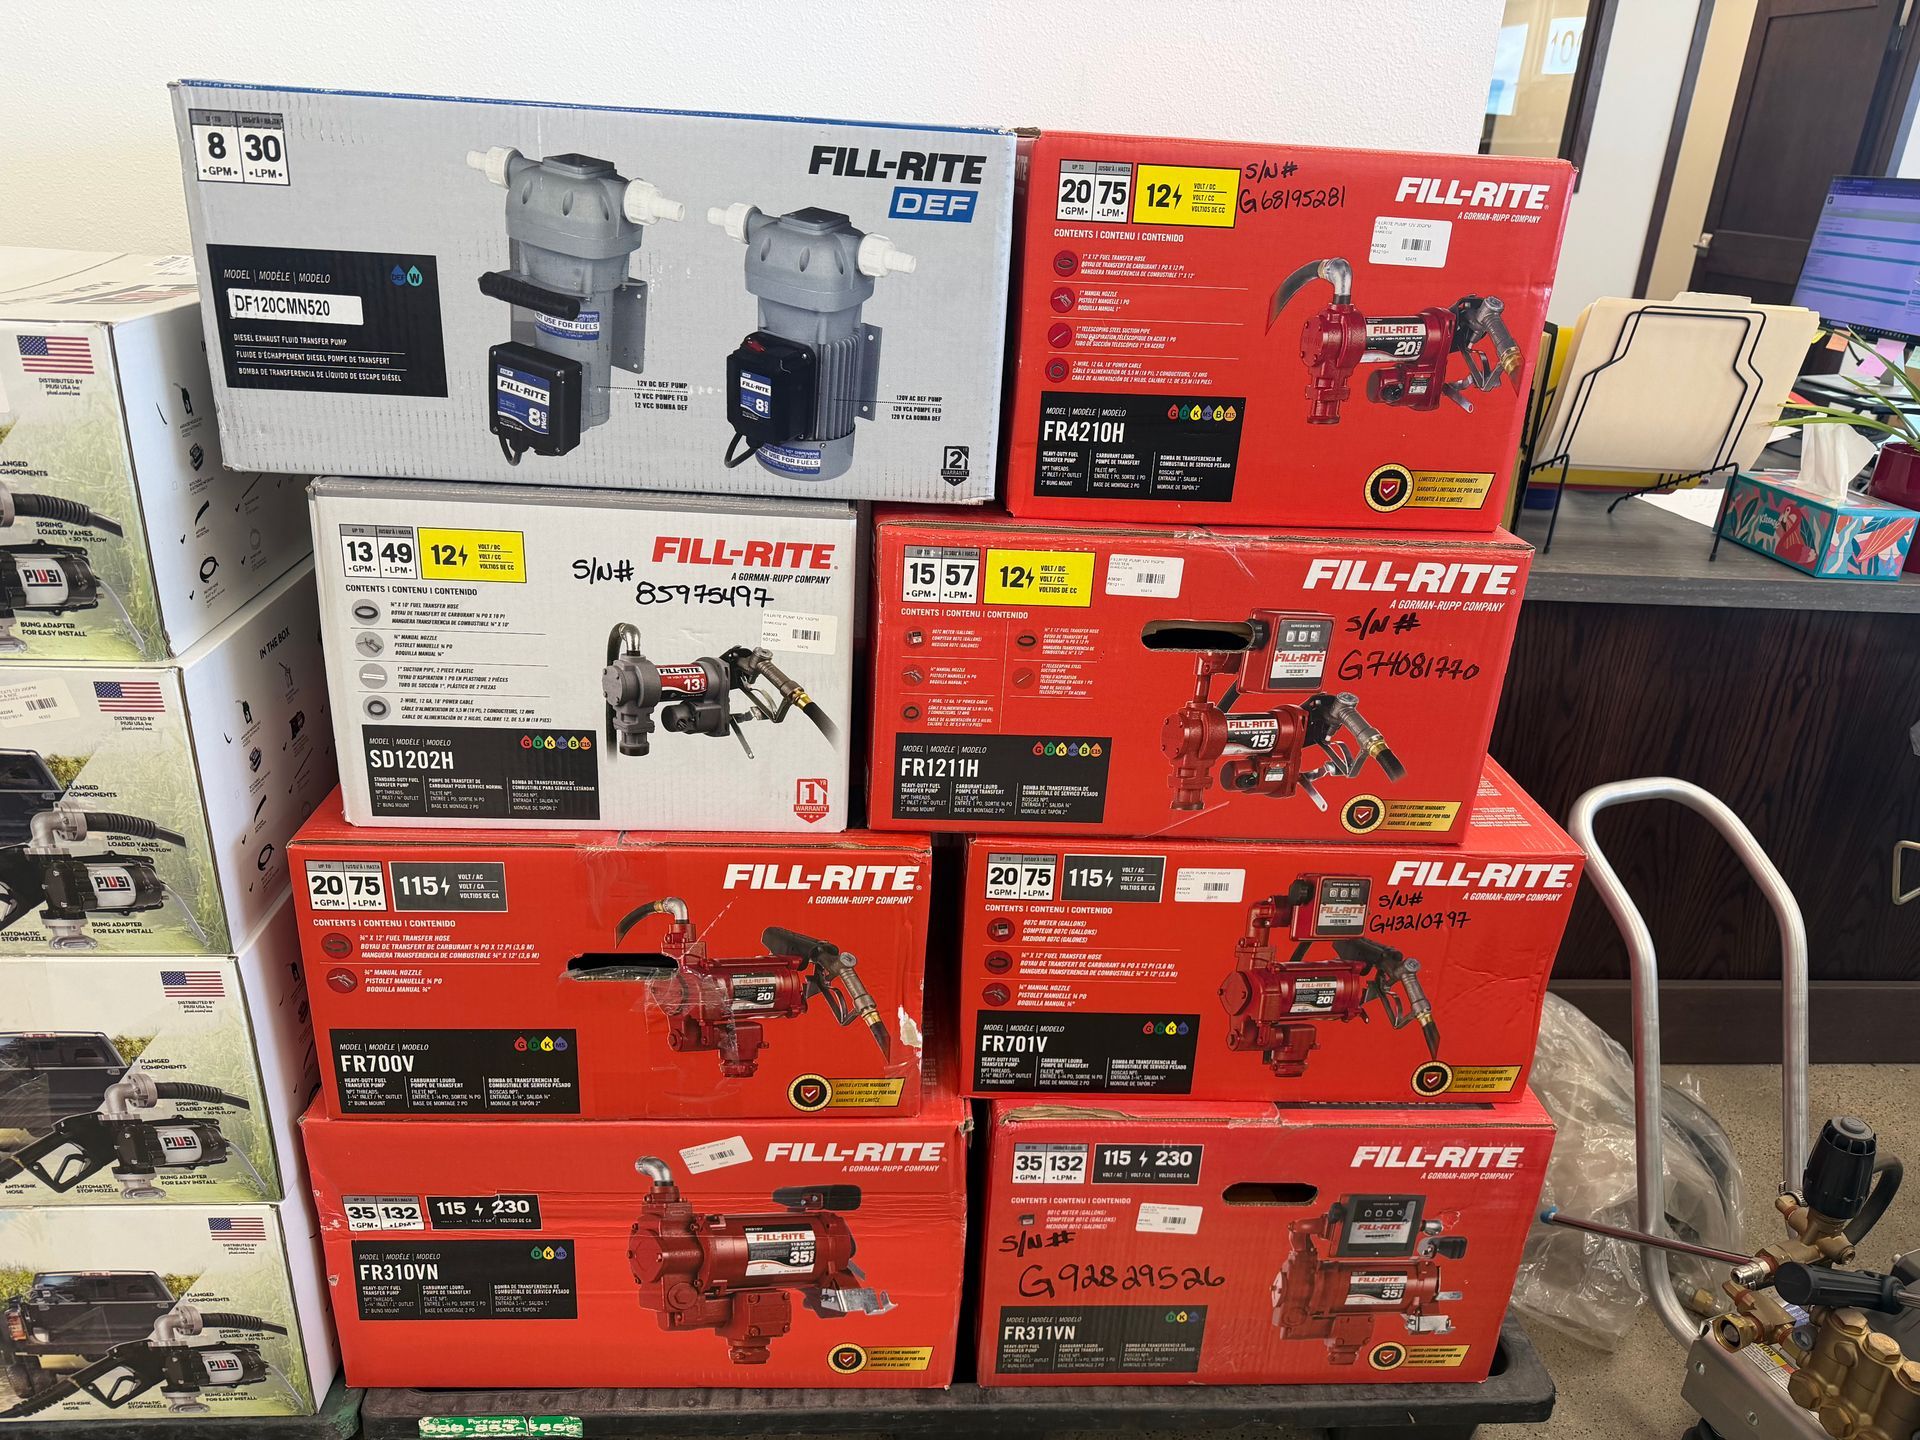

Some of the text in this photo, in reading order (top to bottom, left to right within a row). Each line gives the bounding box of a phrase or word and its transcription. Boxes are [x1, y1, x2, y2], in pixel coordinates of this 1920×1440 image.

[208, 133, 282, 162] 8 30
[208, 166, 277, 179] GPM LPM
[808, 145, 986, 184] FILL-RITE
[1061, 180, 1126, 205] 20 75
[1147, 184, 1170, 207] 12
[1240, 186, 1345, 213] G68195281
[1395, 177, 1550, 209] FILL-RITE
[896, 193, 970, 215] DEF
[1066, 207, 1120, 217] GPM LPM
[1464, 212, 1509, 222] GORMAN-RUPP
[1511, 215, 1541, 223] COMPANY
[1054, 229, 1183, 242] CONTENTS CONTENU CONTENIDO
[224, 269, 330, 284] MODEL MODÈLE MODELO
[235, 295, 330, 317] DF120CMN520
[234, 334, 347, 346] DIESEL EXHAUST FLUID TRANSFER PUMP
[1102, 409, 1126, 417] MODELO
[1044, 421, 1125, 443] FR4210H
[949, 450, 962, 468] 2
[347, 542, 412, 563] 13 49
[431, 545, 457, 565] 12
[652, 536, 835, 570] FILL-RITE
[23, 569, 62, 583] PIUSI
[739, 573, 793, 582] GORMAN-RUPP
[795, 575, 830, 584] COMPANY
[910, 563, 975, 586] 15 57
[1000, 566, 1024, 588] 12
[1303, 559, 1517, 595] FILL-RITE
[392, 586, 427, 594] CONTENU
[636, 581, 774, 608] 85975497
[901, 608, 1028, 619] CONTENTS CONTENU CONTENIDO
[1390, 601, 1505, 612] A GORMAN-RUPP COMPANY
[260, 626, 290, 660] IN THE BOX
[1275, 652, 1325, 662] FILL-RITE
[660, 666, 702, 675] FILL-RITE
[903, 745, 923, 753] MODEL
[930, 745, 955, 753] MODÈLE
[370, 750, 454, 770] SD1202H
[901, 758, 979, 777] FR1211H
[96, 876, 129, 888] PIUSI
[723, 864, 920, 890] FILL-RITE
[990, 867, 1051, 886] 20 75
[1070, 869, 1103, 888] 115
[1387, 861, 1574, 889] FILL-RITE
[311, 876, 380, 895] 20 75
[400, 877, 437, 895] 115
[816, 896, 874, 904] GORMAN-RUPP
[876, 896, 913, 904] COMPANY
[1471, 893, 1524, 901] GORMAN-RUPP
[1526, 893, 1562, 901] COMPANY
[313, 919, 356, 927] CONTENTS
[409, 920, 456, 928] CONTENIDO
[369, 1043, 395, 1051] MODÈLE
[982, 1036, 1048, 1053] FR701V
[341, 1055, 414, 1072] FR700V
[163, 1136, 195, 1147] PIUSI
[765, 1143, 945, 1162] FILL-RITE
[1103, 1151, 1192, 1166] 115 230
[1350, 1146, 1524, 1168] FILL-RITE
[1016, 1156, 1083, 1172] 35 132
[349, 1206, 418, 1220] 35 132
[437, 1201, 530, 1215] 115 230
[756, 1233, 805, 1241] FILL-RITE
[360, 1265, 439, 1281] FR310VN
[1004, 1326, 1075, 1340] FR311VN
[208, 1360, 237, 1370] PIUSI
